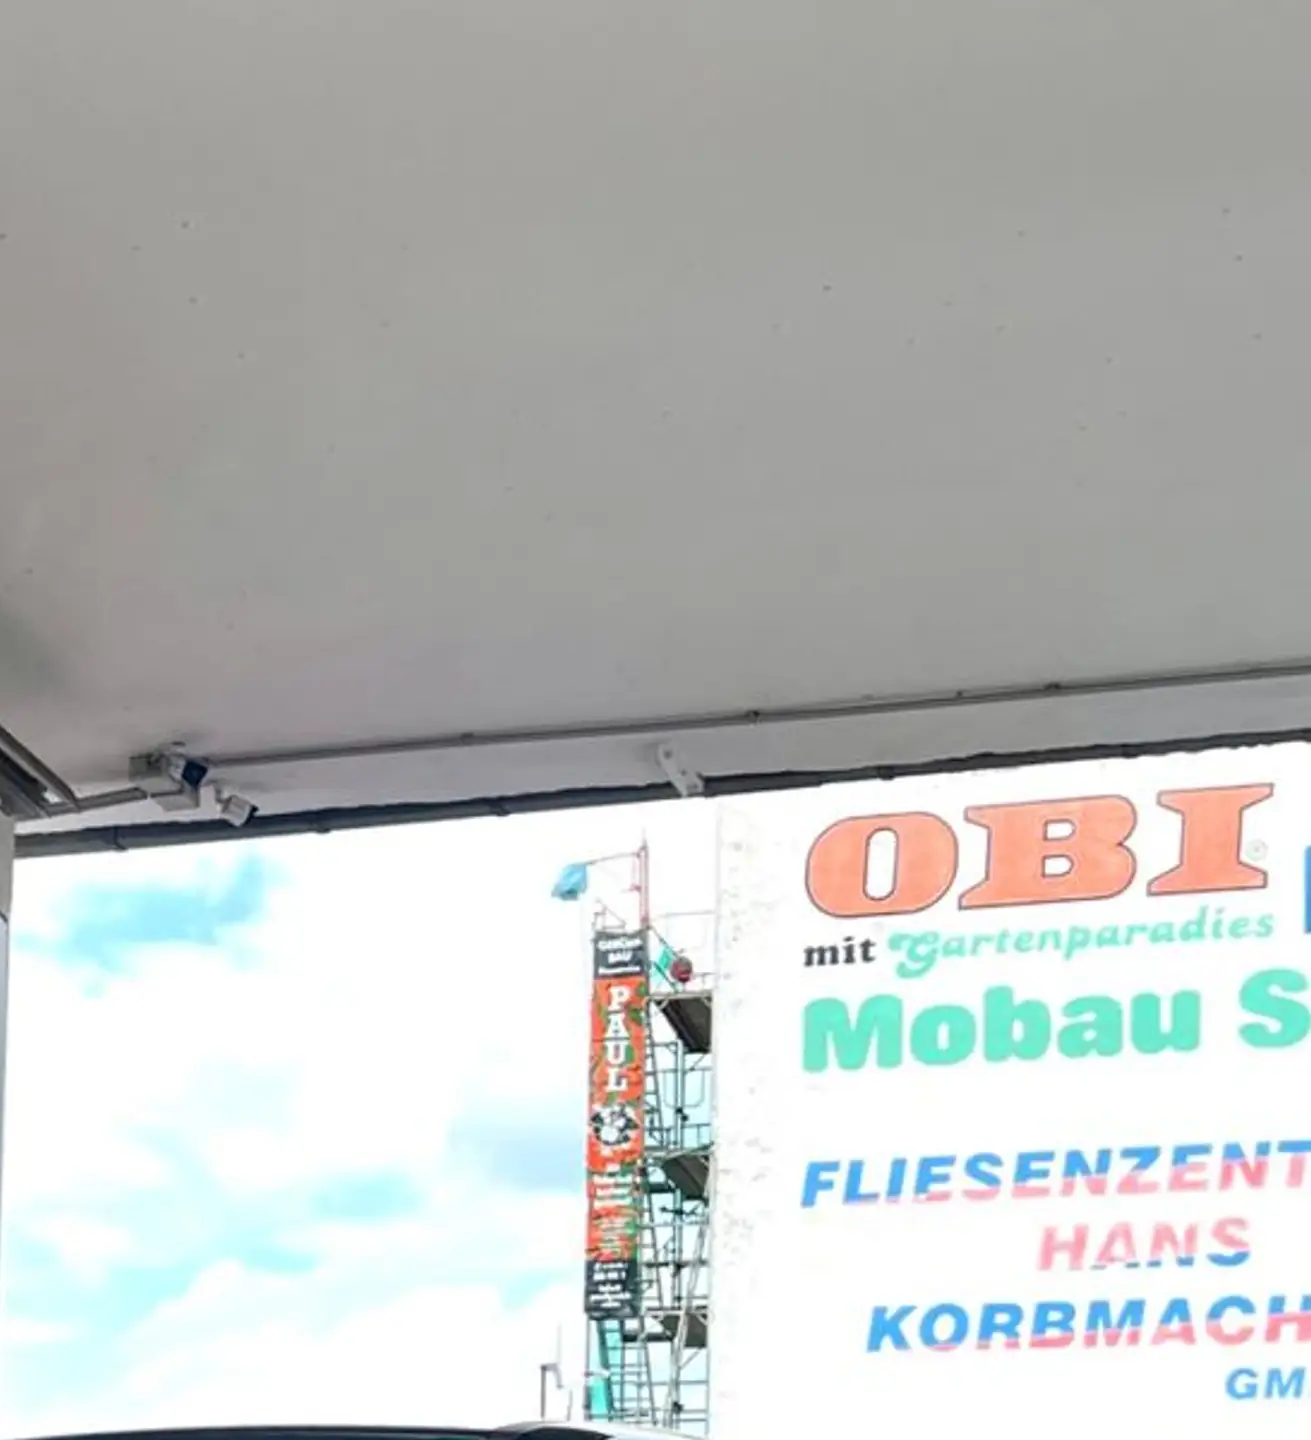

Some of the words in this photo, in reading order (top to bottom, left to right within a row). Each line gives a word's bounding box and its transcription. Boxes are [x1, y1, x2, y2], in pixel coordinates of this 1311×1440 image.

[805, 782, 1275, 919] OBI
[803, 935, 876, 967] mit
[888, 904, 1275, 980] Gartenparadies
[603, 985, 631, 1093] PAUL
[802, 985, 1201, 1073] Mobau
[801, 1139, 1311, 1208] FLIESENZENT
[1036, 1217, 1250, 1272] HANS
[866, 1295, 1311, 1353] KORBMACH
[1225, 1366, 1311, 1402] GM
